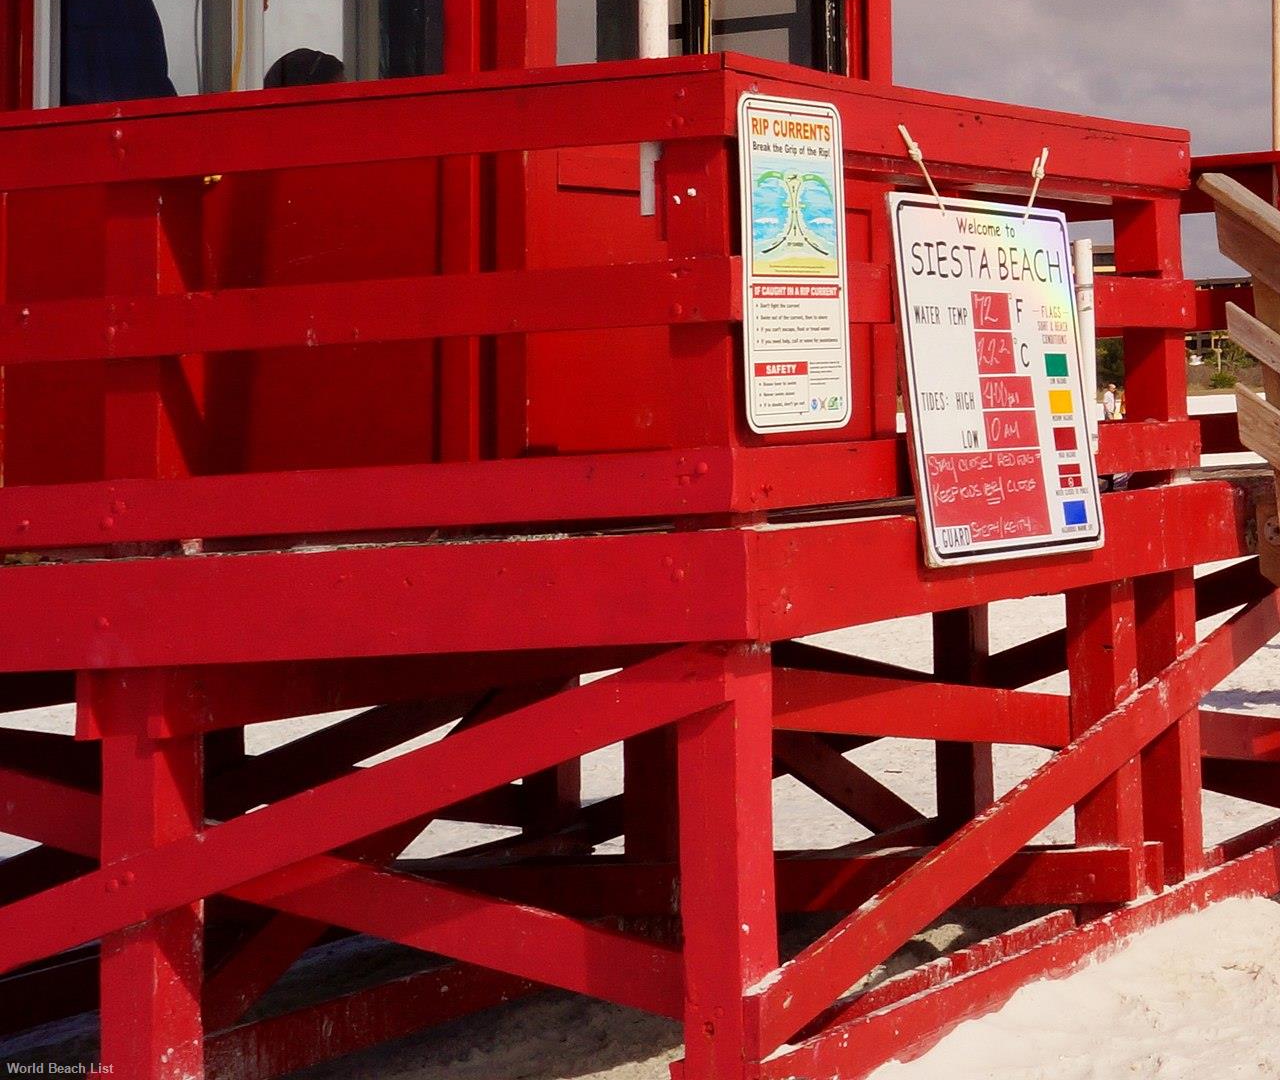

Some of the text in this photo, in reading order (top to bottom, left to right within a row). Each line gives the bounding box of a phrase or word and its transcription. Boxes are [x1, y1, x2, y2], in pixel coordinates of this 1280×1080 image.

[751, 117, 831, 141] RIP CURRENTS
[752, 141, 831, 159] Break the Grip of the Rip!
[956, 217, 1016, 238] Welcome to
[911, 241, 1063, 284] SIESTA BEACH
[913, 306, 968, 326] WATER TEMP
[974, 293, 998, 326] 72
[1041, 305, 1062, 319] FLAGS
[766, 364, 797, 375] SAFETY
[921, 392, 976, 411] TIDES: HIGH
[961, 430, 980, 449] LOW
[941, 527, 971, 548] GUARD
